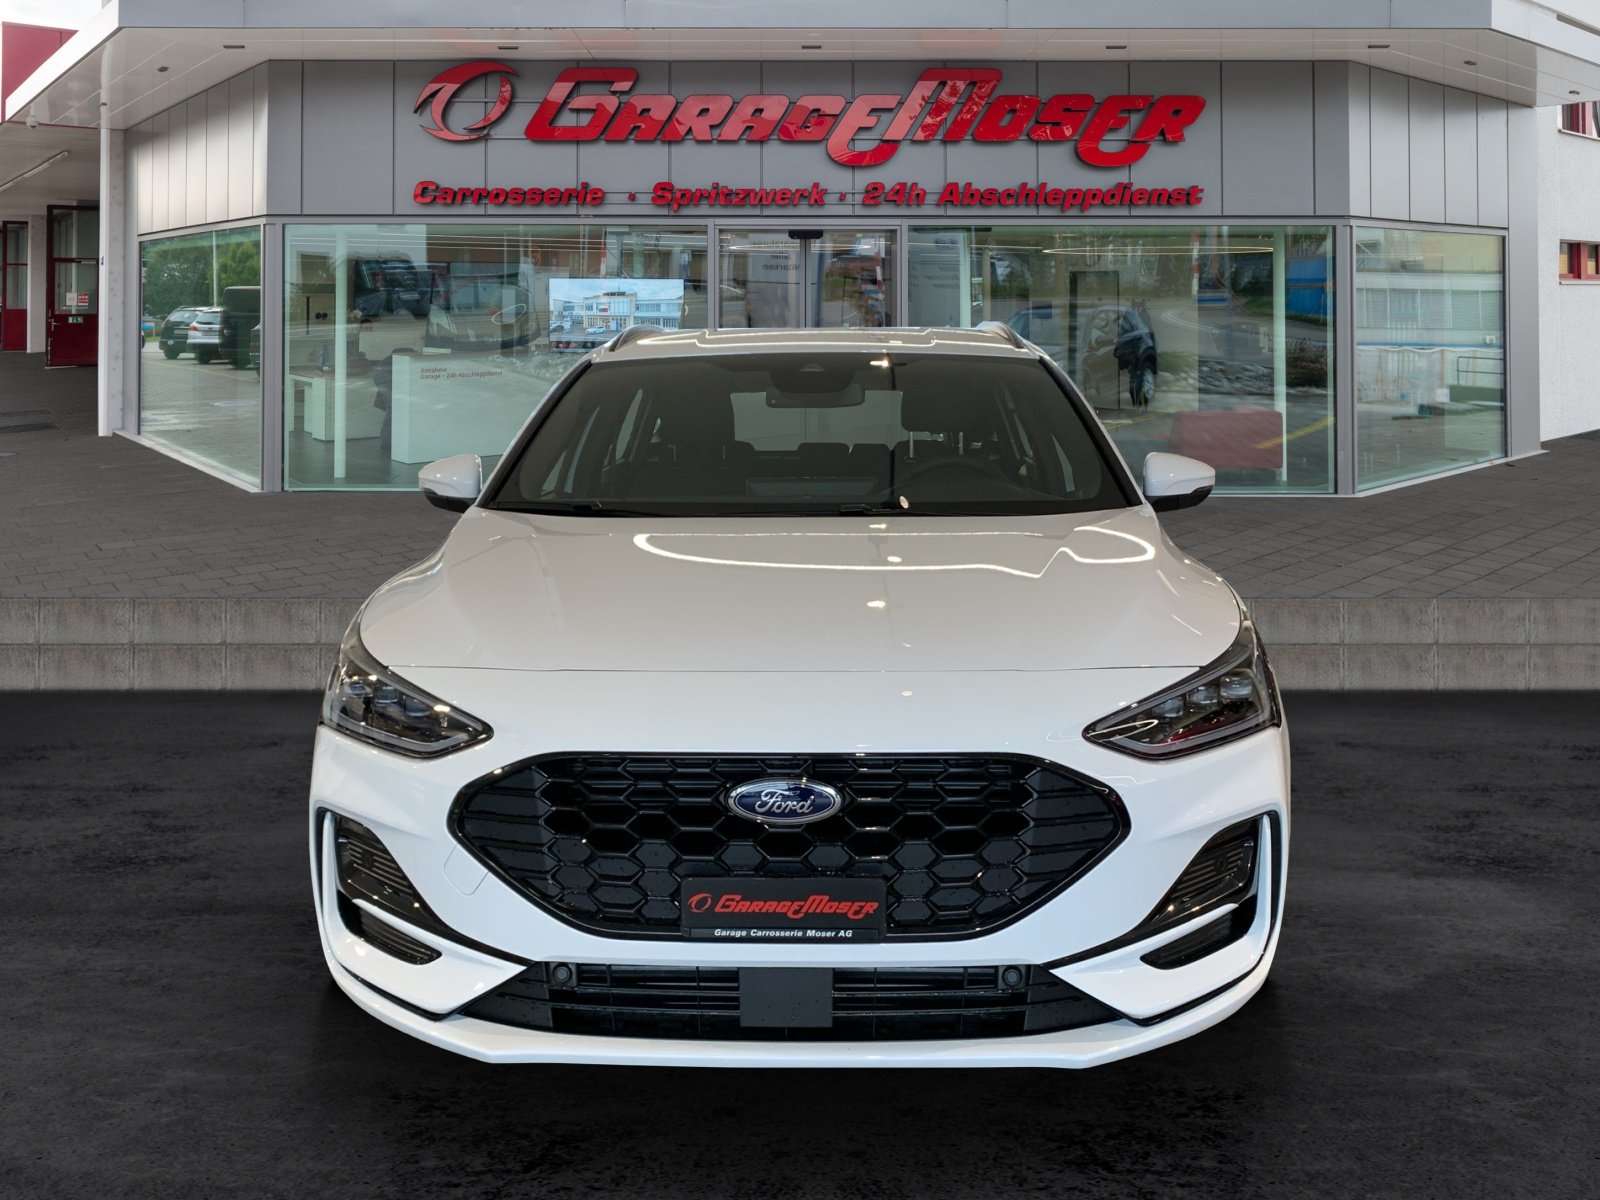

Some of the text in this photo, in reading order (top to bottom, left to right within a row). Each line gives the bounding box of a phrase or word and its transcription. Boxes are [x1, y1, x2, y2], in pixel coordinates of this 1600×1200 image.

[413, 181, 1204, 212] Carrosserie Spritzwerk 24h Abschleppdienst
[458, 370, 503, 379] Abschleppdienst
[755, 789, 814, 813] Ford
[714, 929, 853, 937] Garage Carrosserie Moser AG
